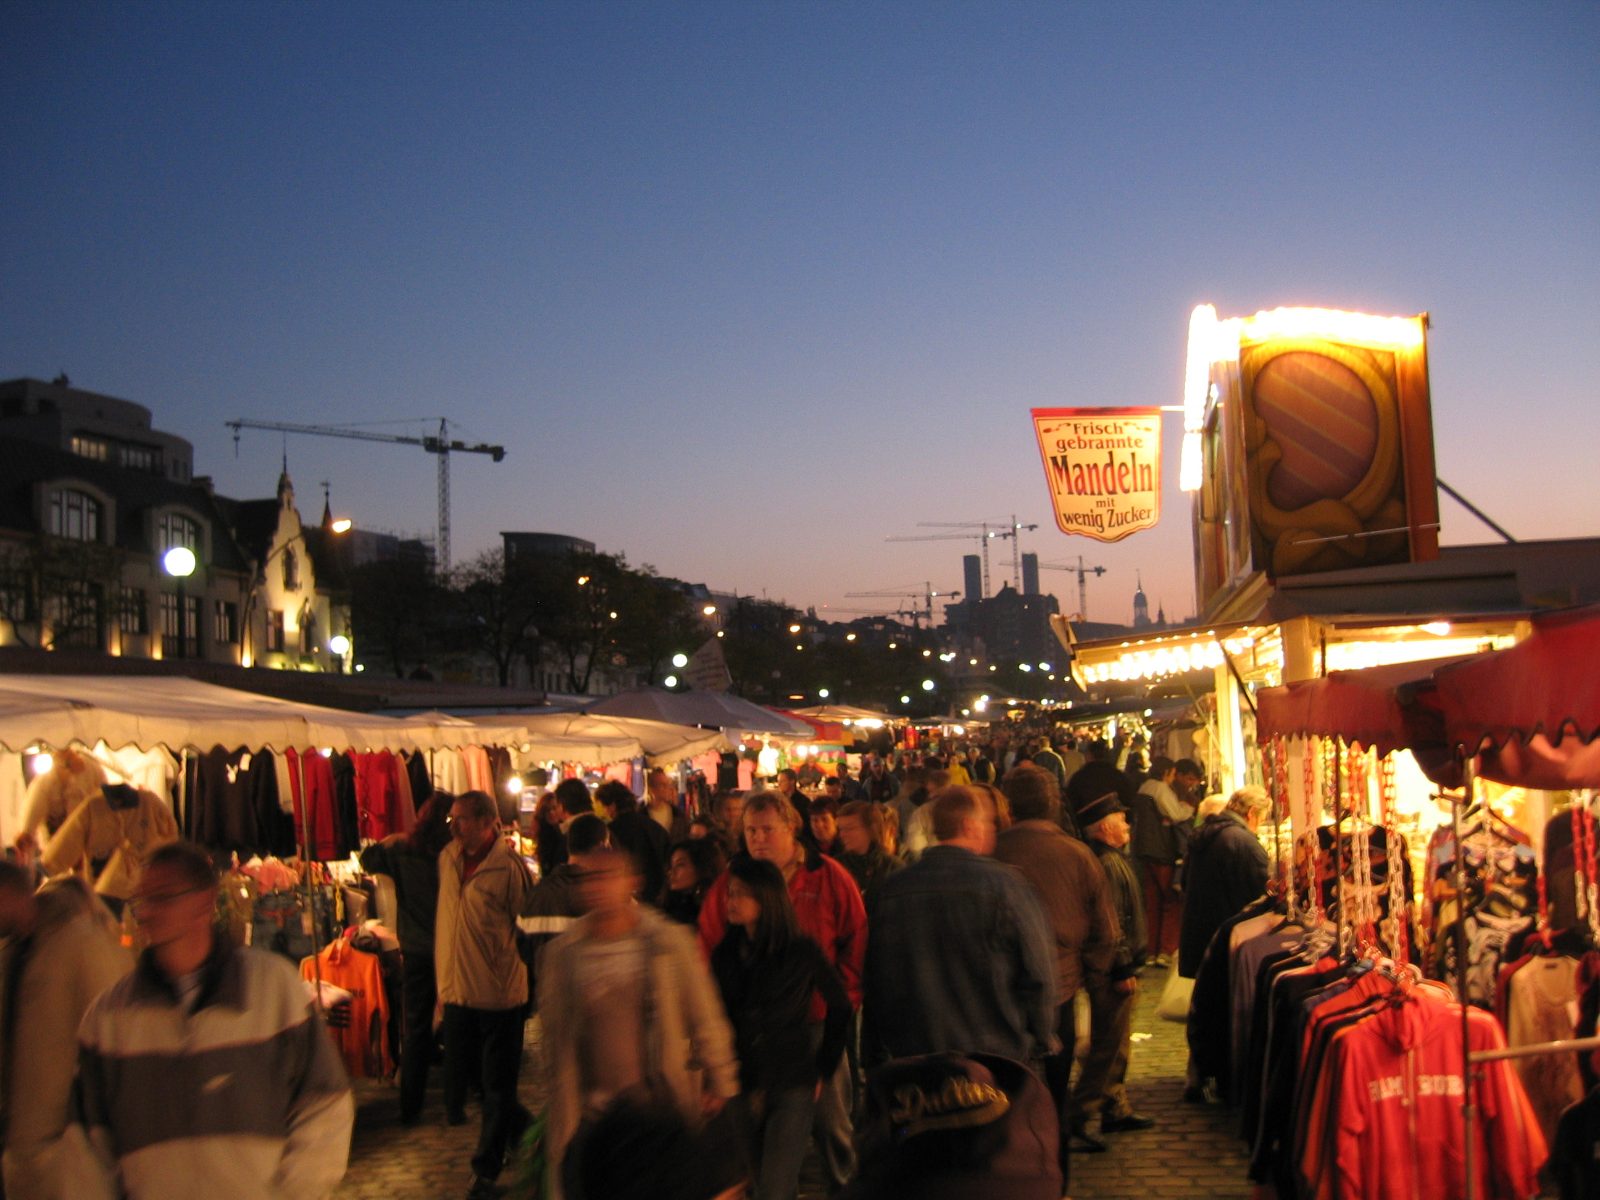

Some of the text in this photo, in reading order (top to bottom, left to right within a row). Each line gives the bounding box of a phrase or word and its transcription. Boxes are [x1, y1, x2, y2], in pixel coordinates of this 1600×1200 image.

[1074, 422, 1123, 435] Frisch
[1056, 437, 1143, 453] gebrannte
[1050, 451, 1153, 496] Mandeln
[1096, 498, 1115, 508] mit
[1063, 507, 1152, 533] wenig Zucker
